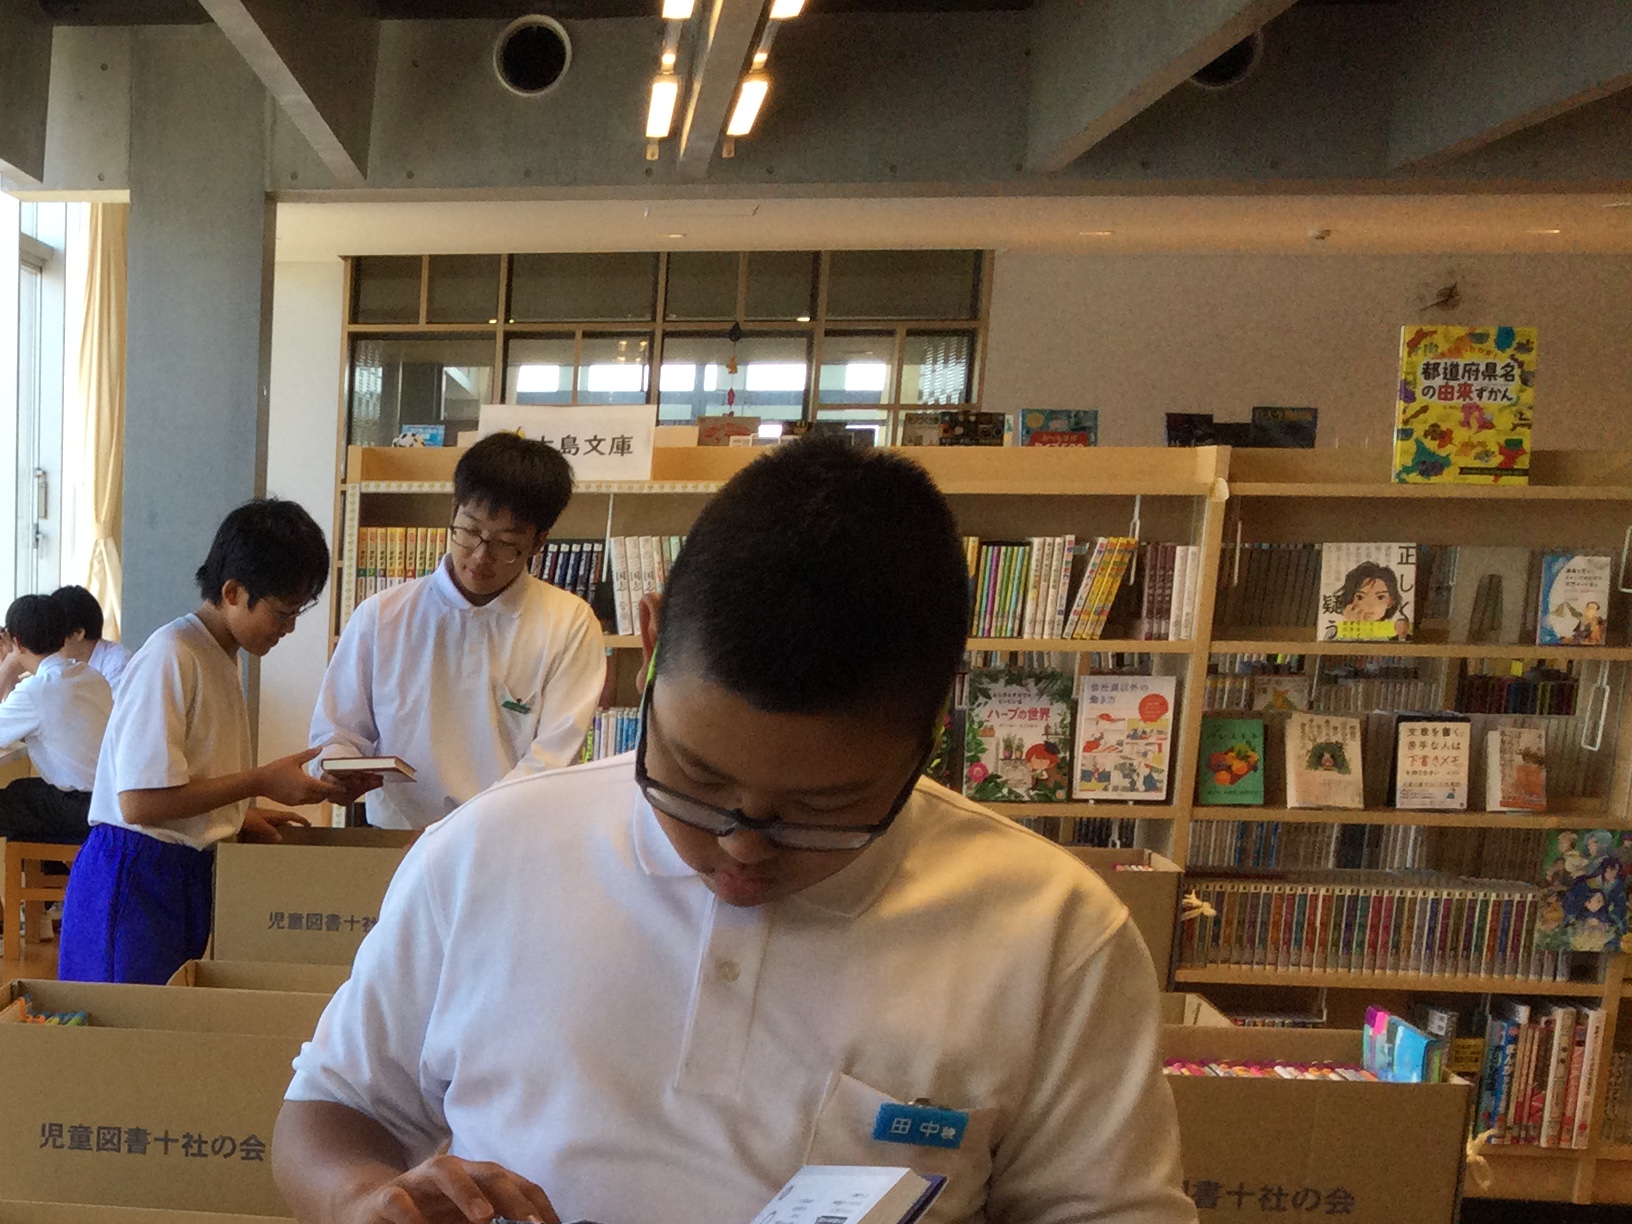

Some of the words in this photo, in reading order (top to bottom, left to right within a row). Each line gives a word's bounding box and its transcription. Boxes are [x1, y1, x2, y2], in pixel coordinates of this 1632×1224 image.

[1421, 360, 1515, 382] 都道府県名
[1421, 382, 1514, 401] の由来ずかん
[1397, 545, 1416, 620] 正しく
[1322, 594, 1343, 641] 疑う
[39, 1122, 267, 1162] 児童図書十社の会
[1183, 1179, 1356, 1215] 書十社の会
